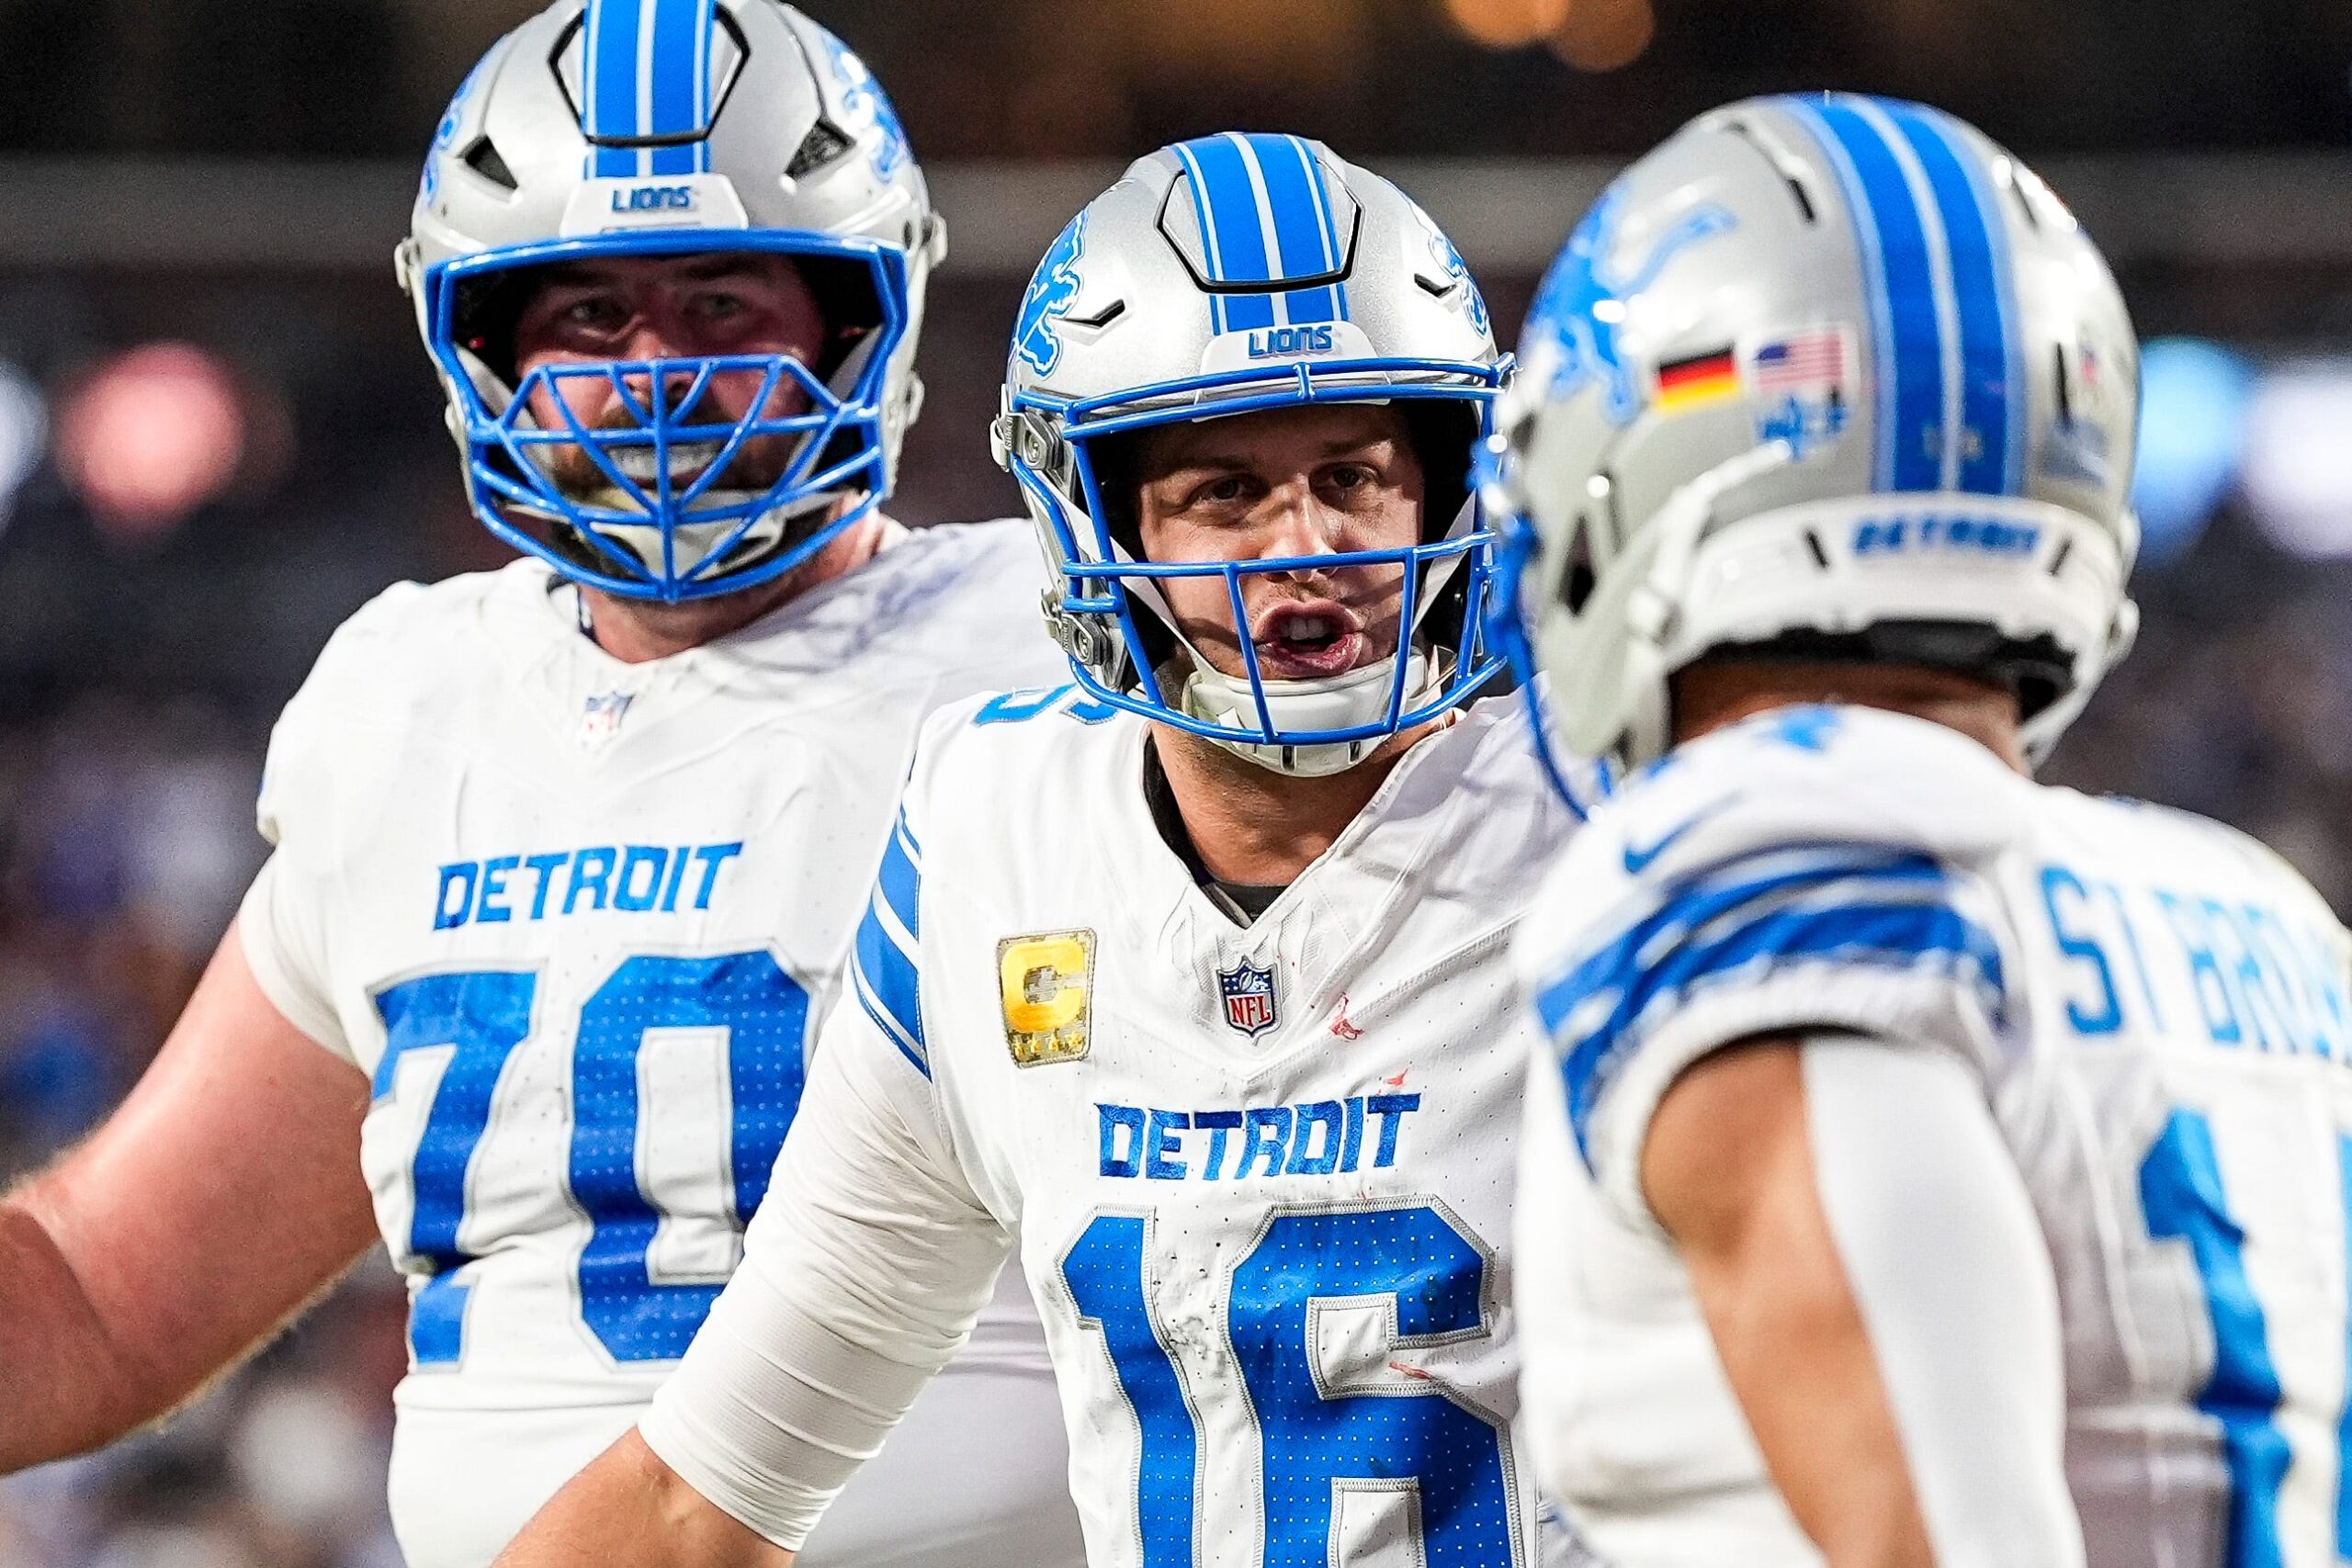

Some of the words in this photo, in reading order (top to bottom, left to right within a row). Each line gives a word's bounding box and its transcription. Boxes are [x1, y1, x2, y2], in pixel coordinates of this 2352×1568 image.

[1249, 325, 1332, 356] LIONS
[432, 840, 743, 931] DETROIT
[1001, 937, 1086, 1034] C
[1228, 995, 1272, 1028] NFL
[369, 948, 809, 1363] 70
[1094, 1091, 1422, 1181] DETROIT
[1060, 1205, 1516, 1568] 16
